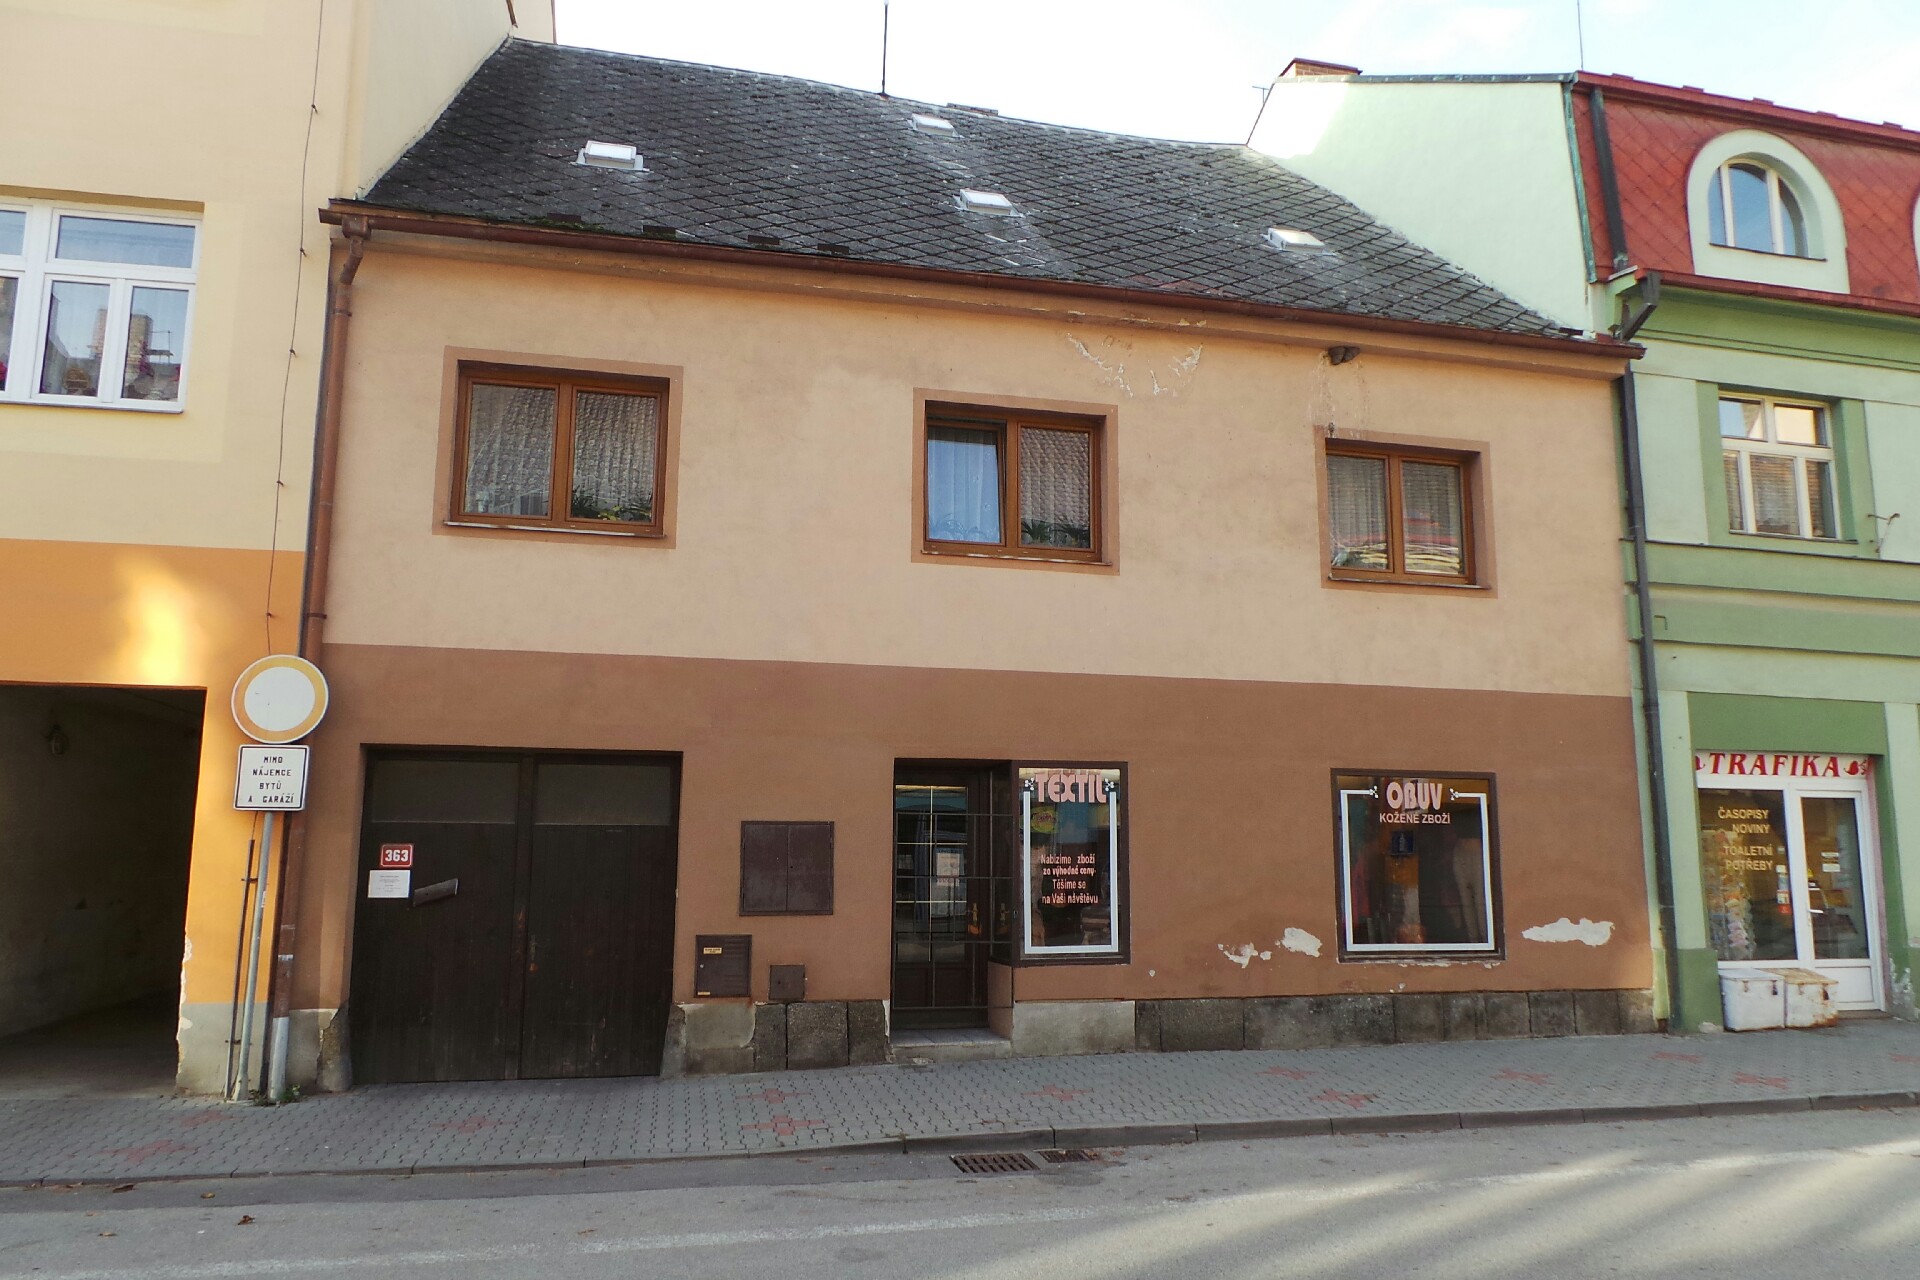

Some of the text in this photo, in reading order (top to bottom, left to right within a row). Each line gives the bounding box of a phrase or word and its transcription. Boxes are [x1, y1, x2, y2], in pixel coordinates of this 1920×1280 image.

[263, 756, 283, 764] MIMO
[1709, 752, 1841, 778] TRAFIKA
[252, 766, 292, 777] NÁJEMCE
[1035, 772, 1107, 803] TEXTIL
[248, 793, 295, 803] A GARÁŽÍ
[1386, 781, 1443, 810] OBUV
[1379, 811, 1451, 824] KOŽENÉ ZBOŽÍ
[1717, 806, 1769, 819] ČASOPISY
[1732, 823, 1771, 834] NOVINY
[384, 849, 409, 862] 363
[1723, 844, 1773, 856] TOALETNÍ
[1077, 853, 1095, 864] zboží
[1725, 858, 1773, 871] POTŘEBY
[1043, 867, 1051, 875] za
[1052, 865, 1079, 877] výhodné
[1077, 880, 1086, 889] se
[1042, 891, 1099, 904] na Vaši návštěvu
